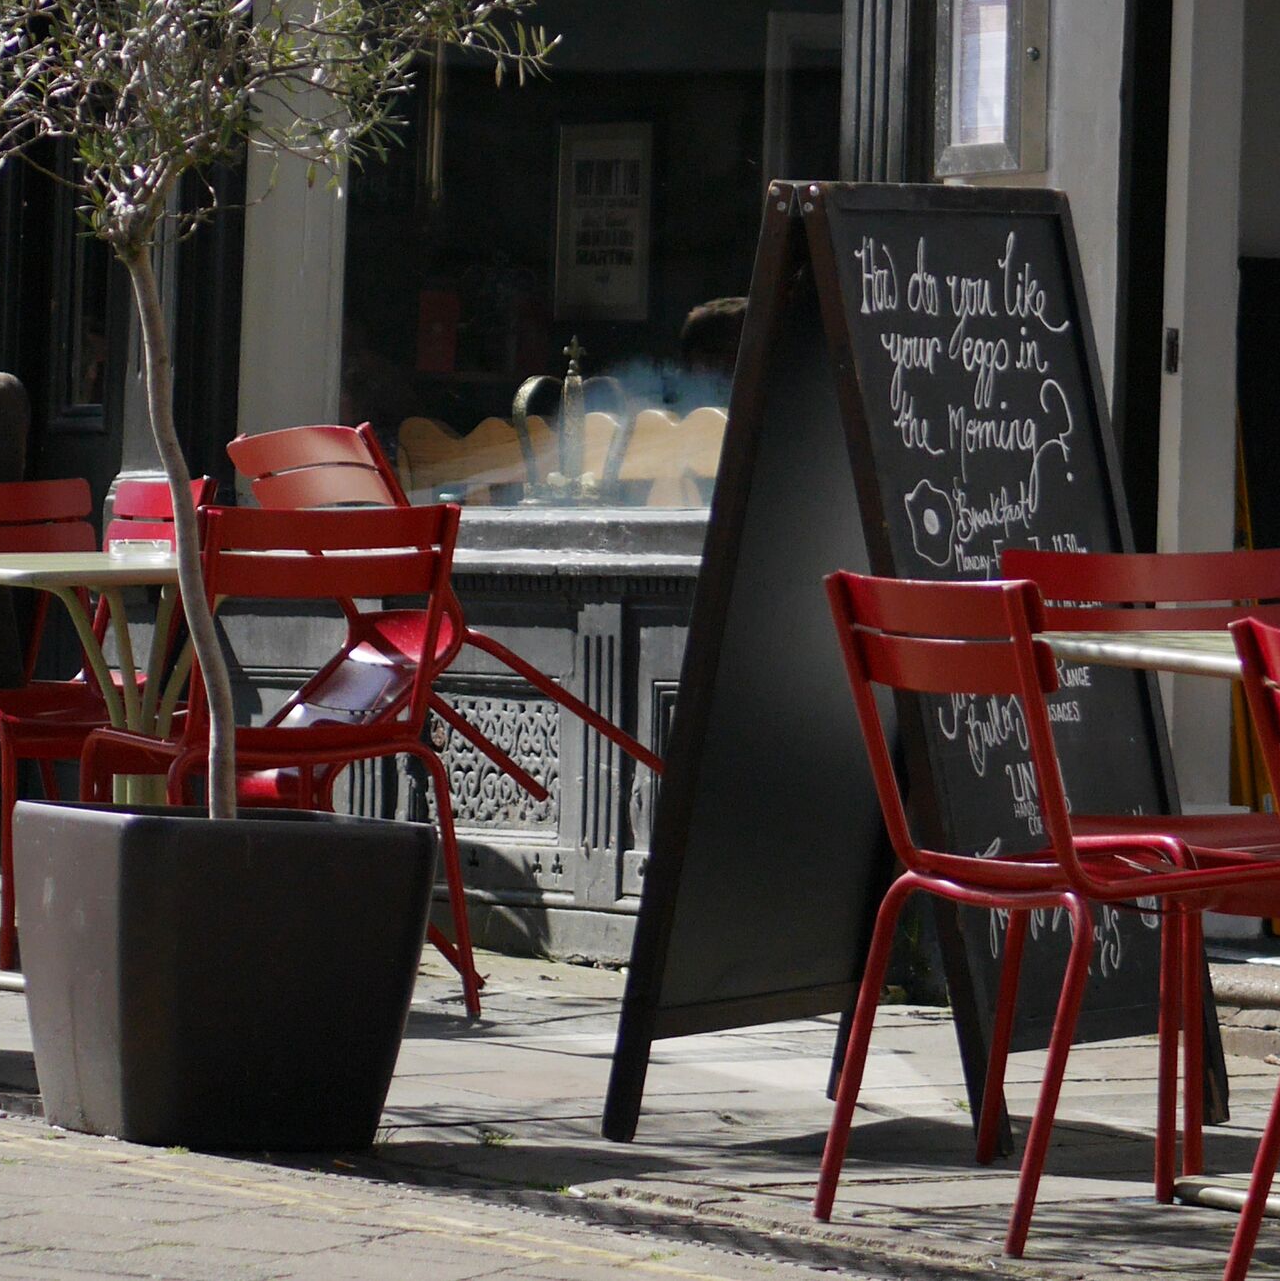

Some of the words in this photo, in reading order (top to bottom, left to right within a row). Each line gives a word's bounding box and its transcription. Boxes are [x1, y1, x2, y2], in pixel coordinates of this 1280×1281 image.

[853, 234, 898, 314] How
[946, 274, 997, 360] you
[997, 230, 1069, 332] like
[881, 332, 942, 411] your
[961, 339, 1009, 410] eggs
[1016, 326, 1048, 374] in
[894, 389, 944, 456] the
[1053, 657, 1092, 687] RANGE
[1048, 701, 1080, 722] SAGES
